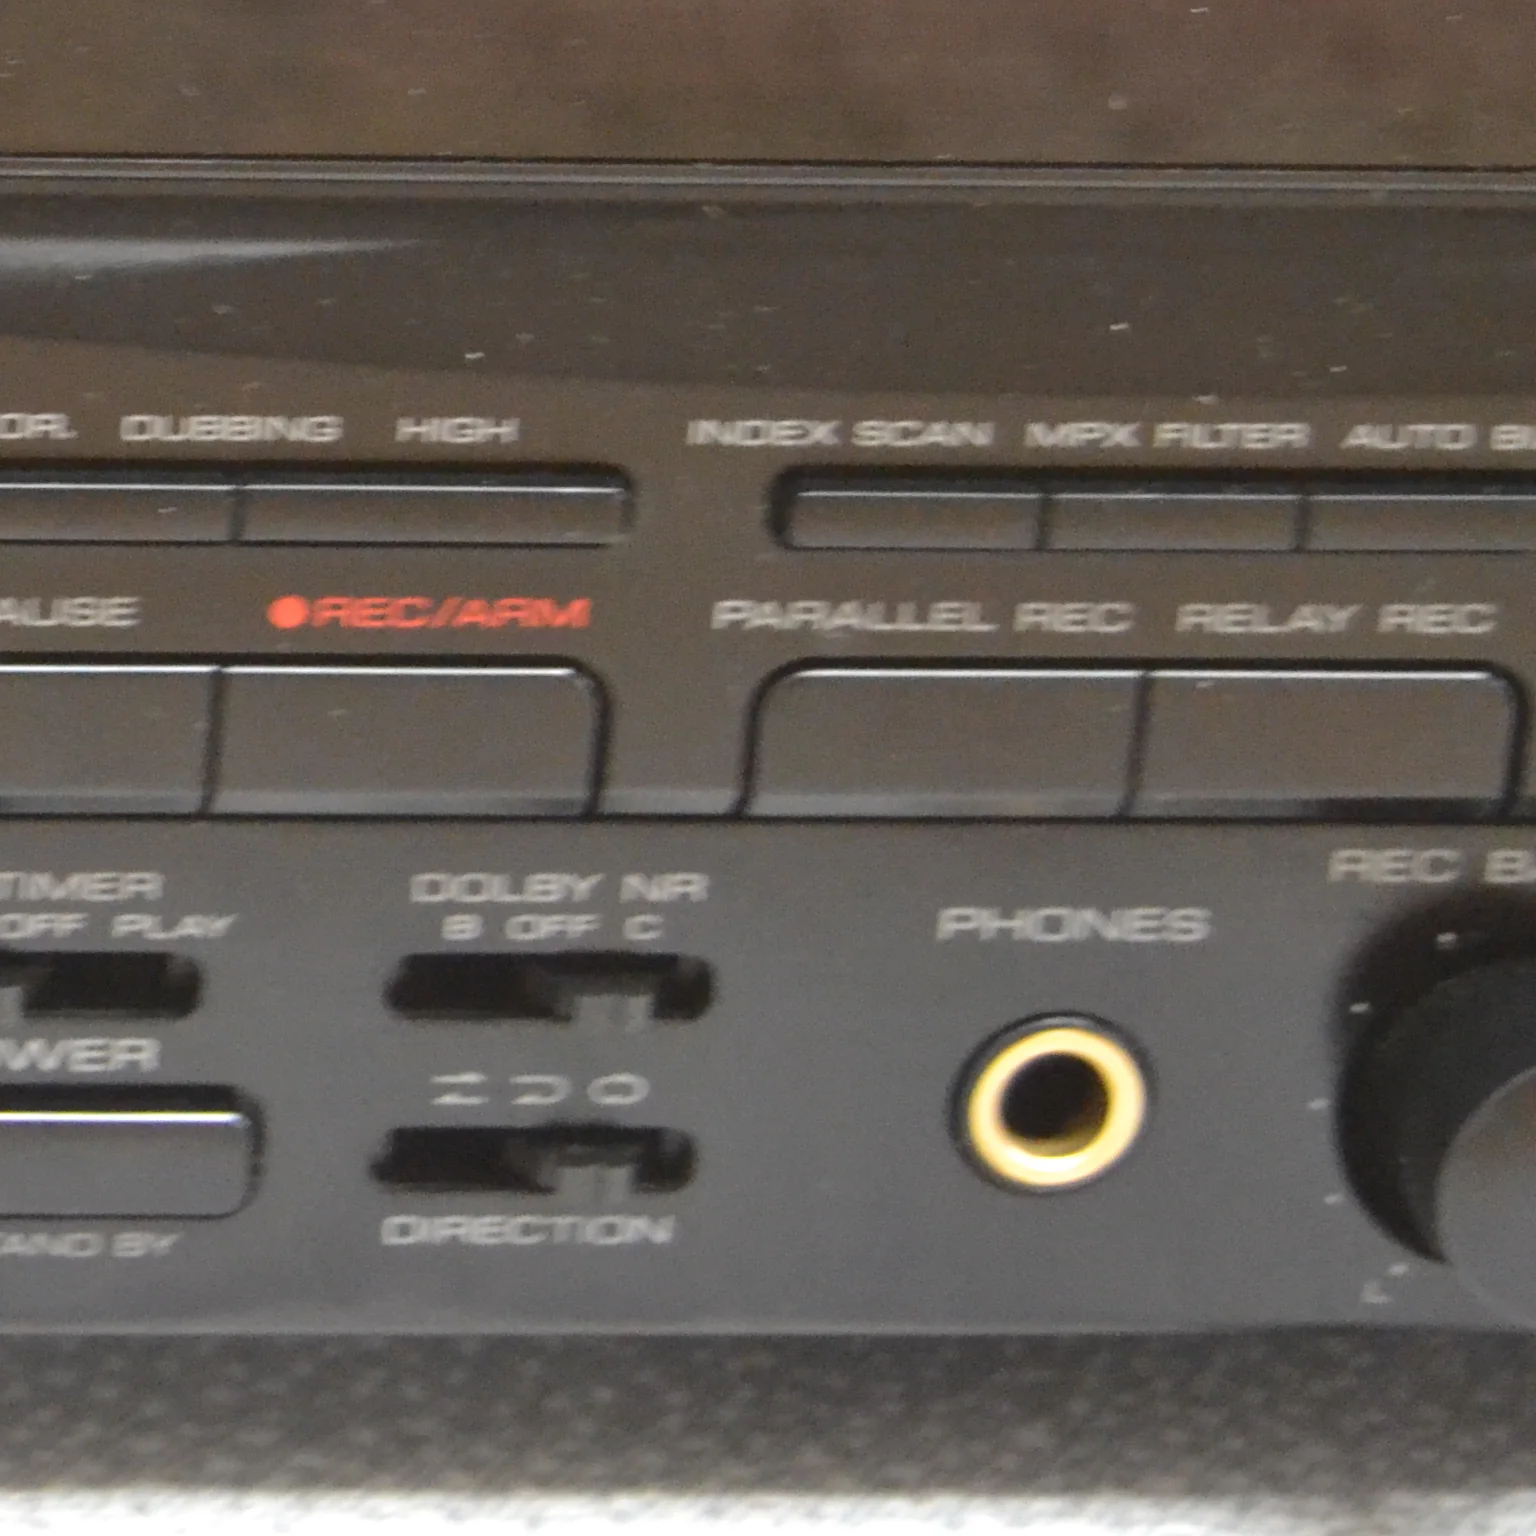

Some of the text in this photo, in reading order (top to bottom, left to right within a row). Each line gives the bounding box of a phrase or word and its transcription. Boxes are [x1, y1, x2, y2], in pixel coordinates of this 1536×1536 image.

[121, 414, 344, 443] DUBBING
[394, 416, 521, 444] HIGH
[684, 419, 996, 448] INDEX SCAN
[1023, 420, 1310, 449] MPX FILTER
[1339, 423, 1477, 450] AUTO
[310, 596, 591, 630] REC/ARM
[710, 600, 1135, 634] PARALLEL REC
[1174, 602, 1498, 636] RELAY REC
[1329, 848, 1461, 883] REC
[409, 872, 708, 904] DOLBY NR
[111, 914, 240, 940] PLAY
[441, 915, 664, 941] B OFF C
[937, 906, 1212, 943] PHONES
[113, 1232, 182, 1260] BY
[381, 1214, 675, 1247] DIRECTION
